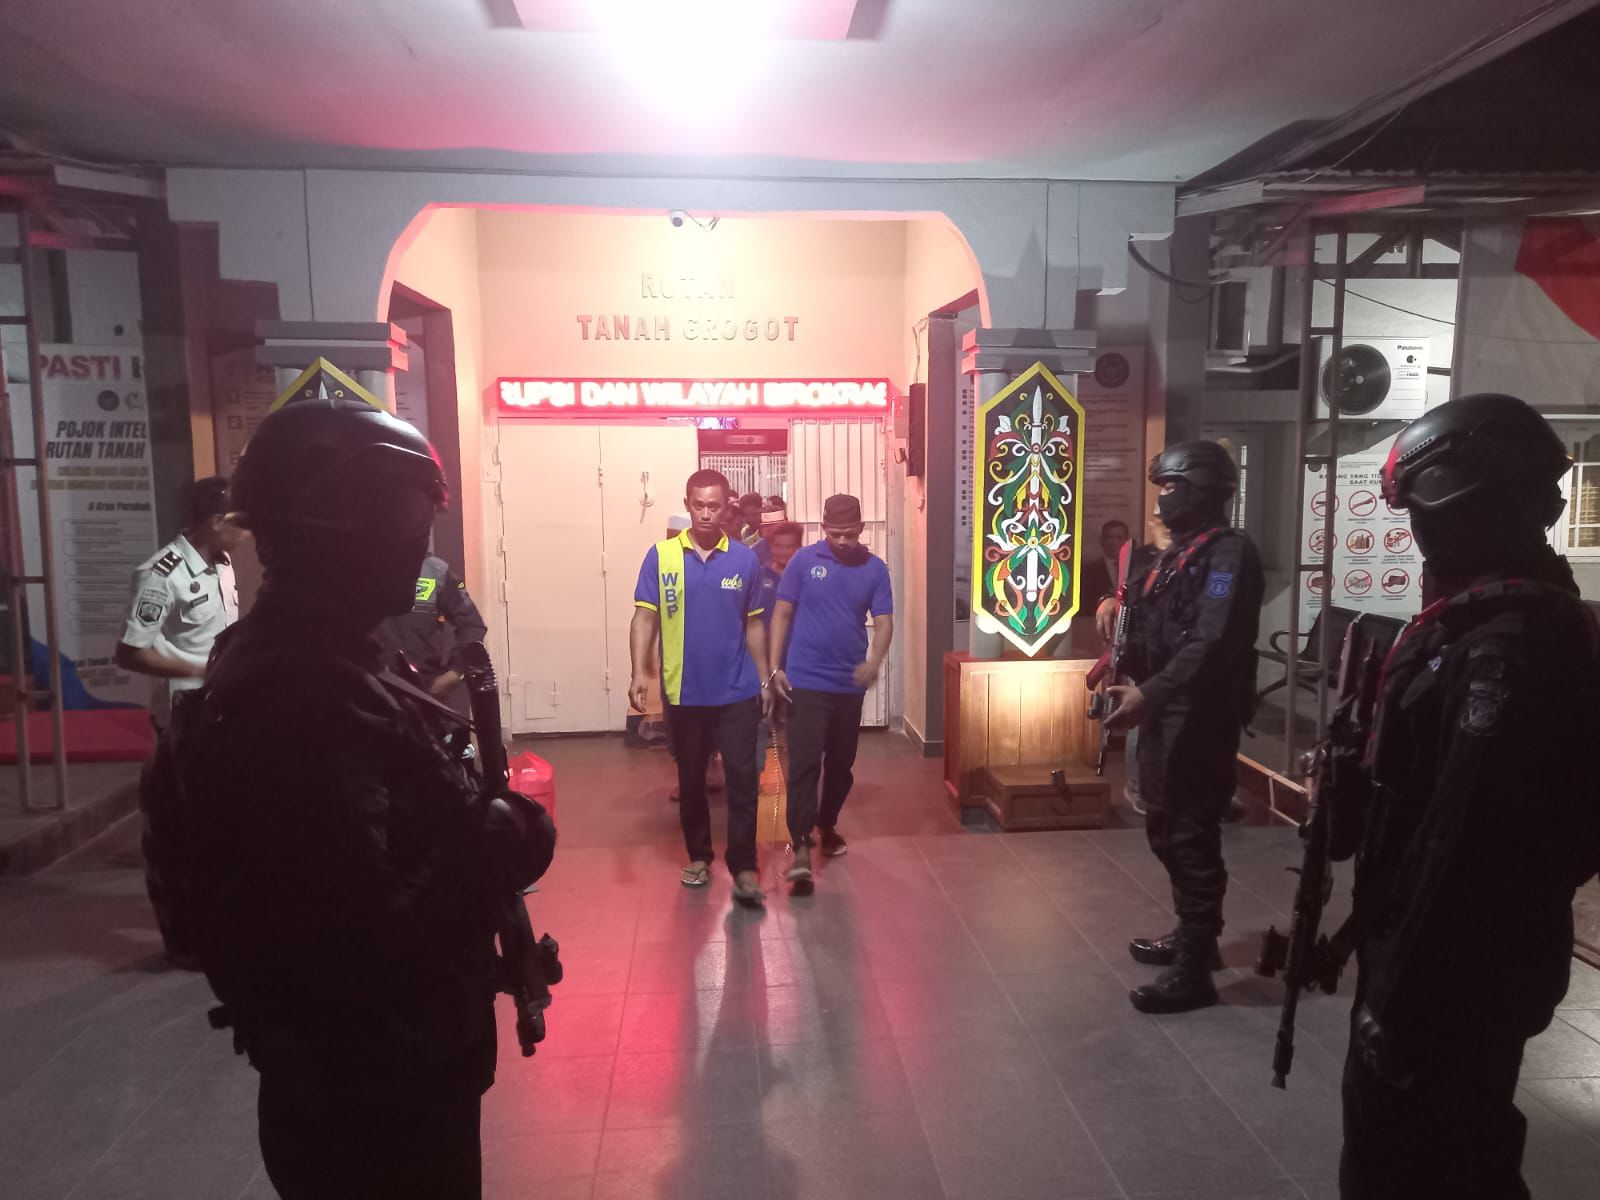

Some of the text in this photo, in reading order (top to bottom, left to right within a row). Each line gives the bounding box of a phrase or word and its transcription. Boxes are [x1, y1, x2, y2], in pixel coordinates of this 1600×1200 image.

[577, 314, 799, 341] TANAH GROGOT
[40, 354, 121, 382] PASTI
[580, 381, 638, 406] DAN
[639, 381, 759, 406] WILAYAH
[56, 420, 147, 439] POJOK INTEL
[46, 441, 146, 459] RUTAN TANAH
[661, 572, 679, 619] WBP
